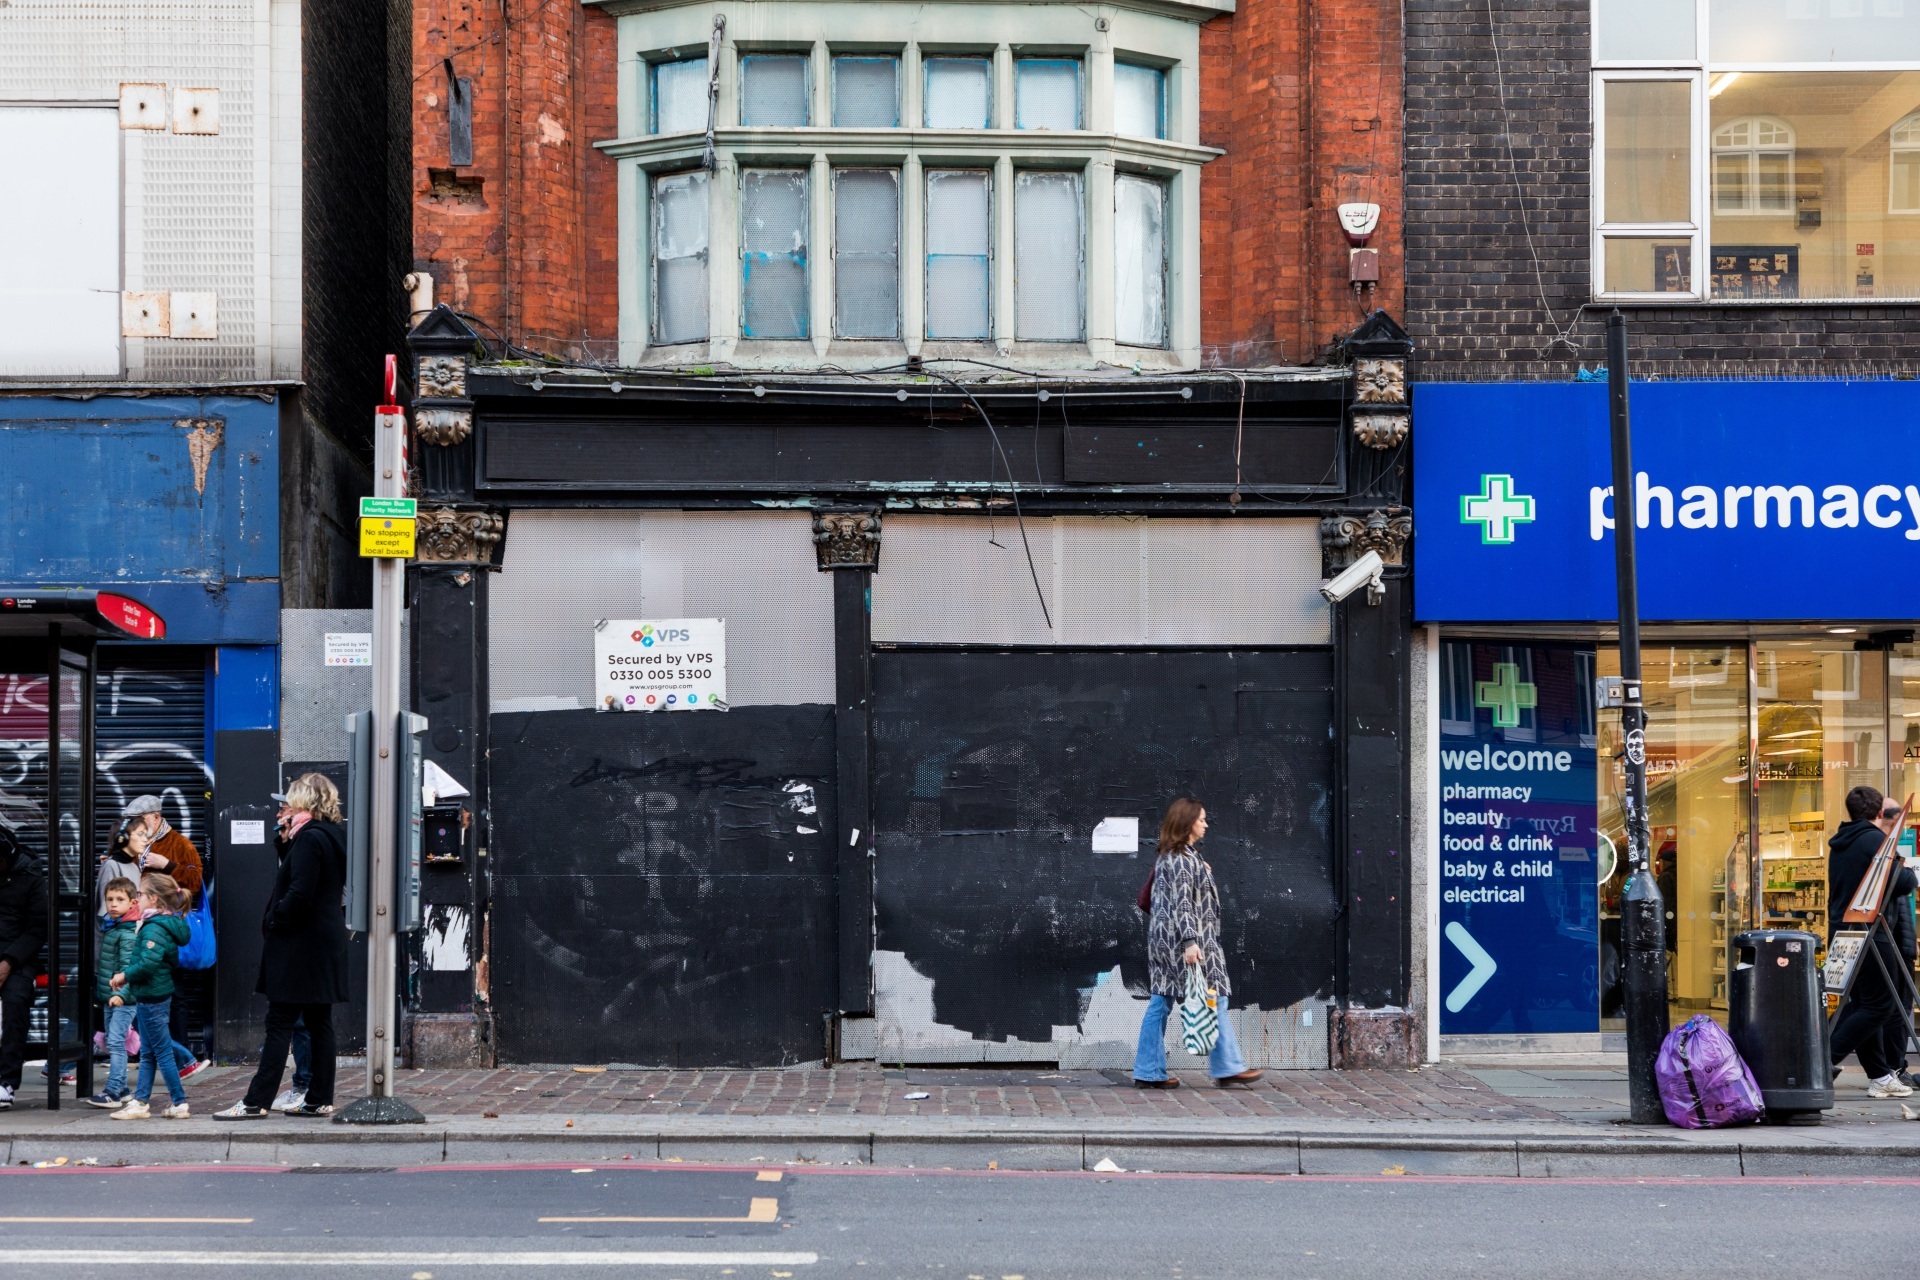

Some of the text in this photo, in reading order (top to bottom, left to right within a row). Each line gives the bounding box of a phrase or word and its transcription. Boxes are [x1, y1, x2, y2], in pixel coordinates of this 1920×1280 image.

[378, 530, 410, 538] stopping
[656, 629, 690, 642] VPS
[608, 653, 713, 665] Secured by VPS
[610, 669, 712, 680] 0330 005 5300
[629, 683, 693, 691] www.vpsgroup.com
[1441, 743, 1573, 772] welcome
[1443, 782, 1532, 803] pharmacy
[1443, 808, 1504, 829] beauty
[1443, 834, 1553, 851] food & drink
[1444, 860, 1553, 881] baby & child
[1443, 886, 1525, 903] electrical
